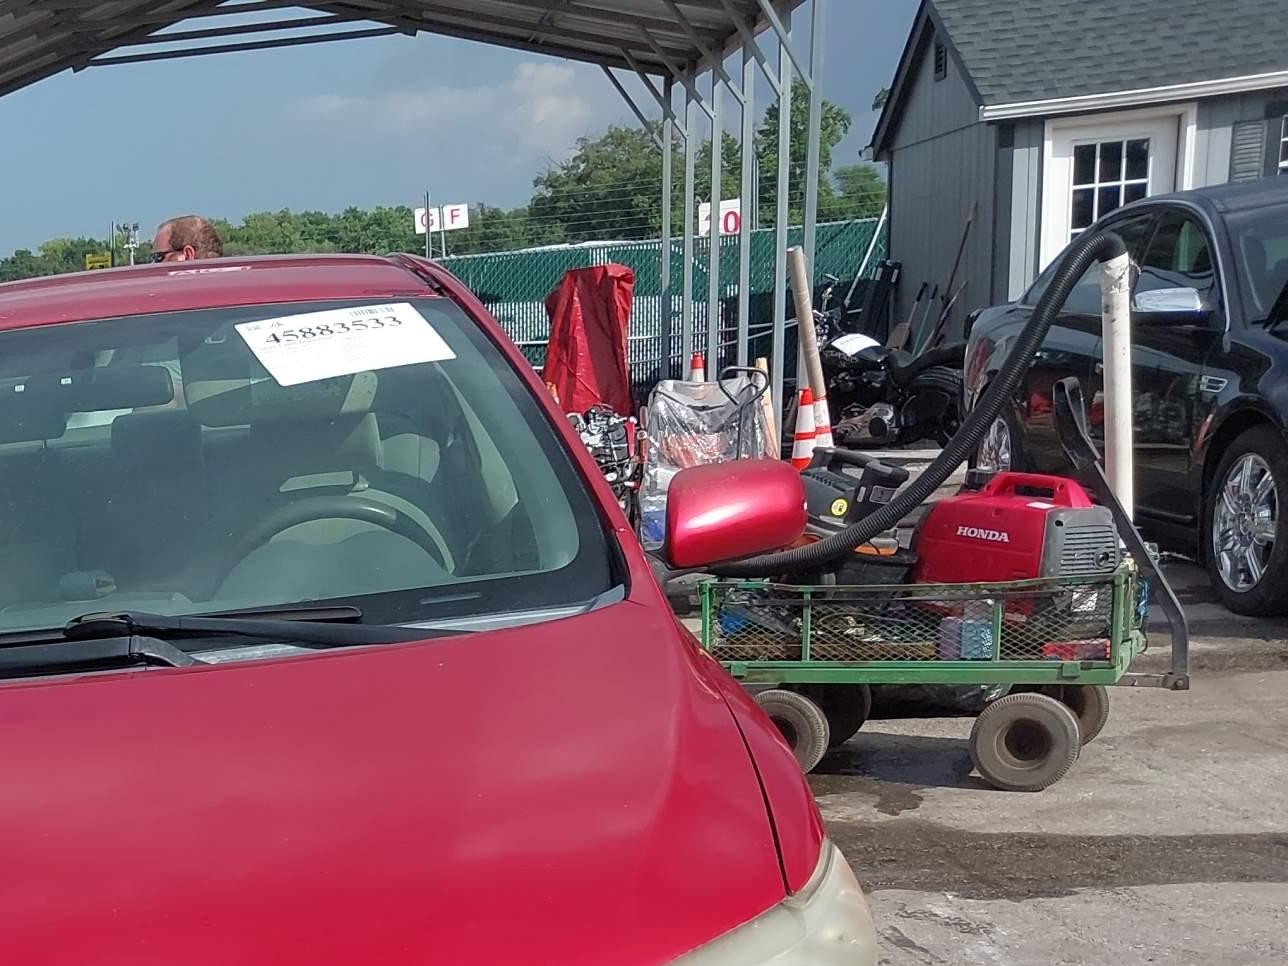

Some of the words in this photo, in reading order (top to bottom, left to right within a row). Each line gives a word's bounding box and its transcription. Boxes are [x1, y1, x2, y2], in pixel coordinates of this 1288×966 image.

[450, 208, 460, 225] F
[266, 316, 402, 343] 45883533
[956, 526, 1010, 543] HONDA
